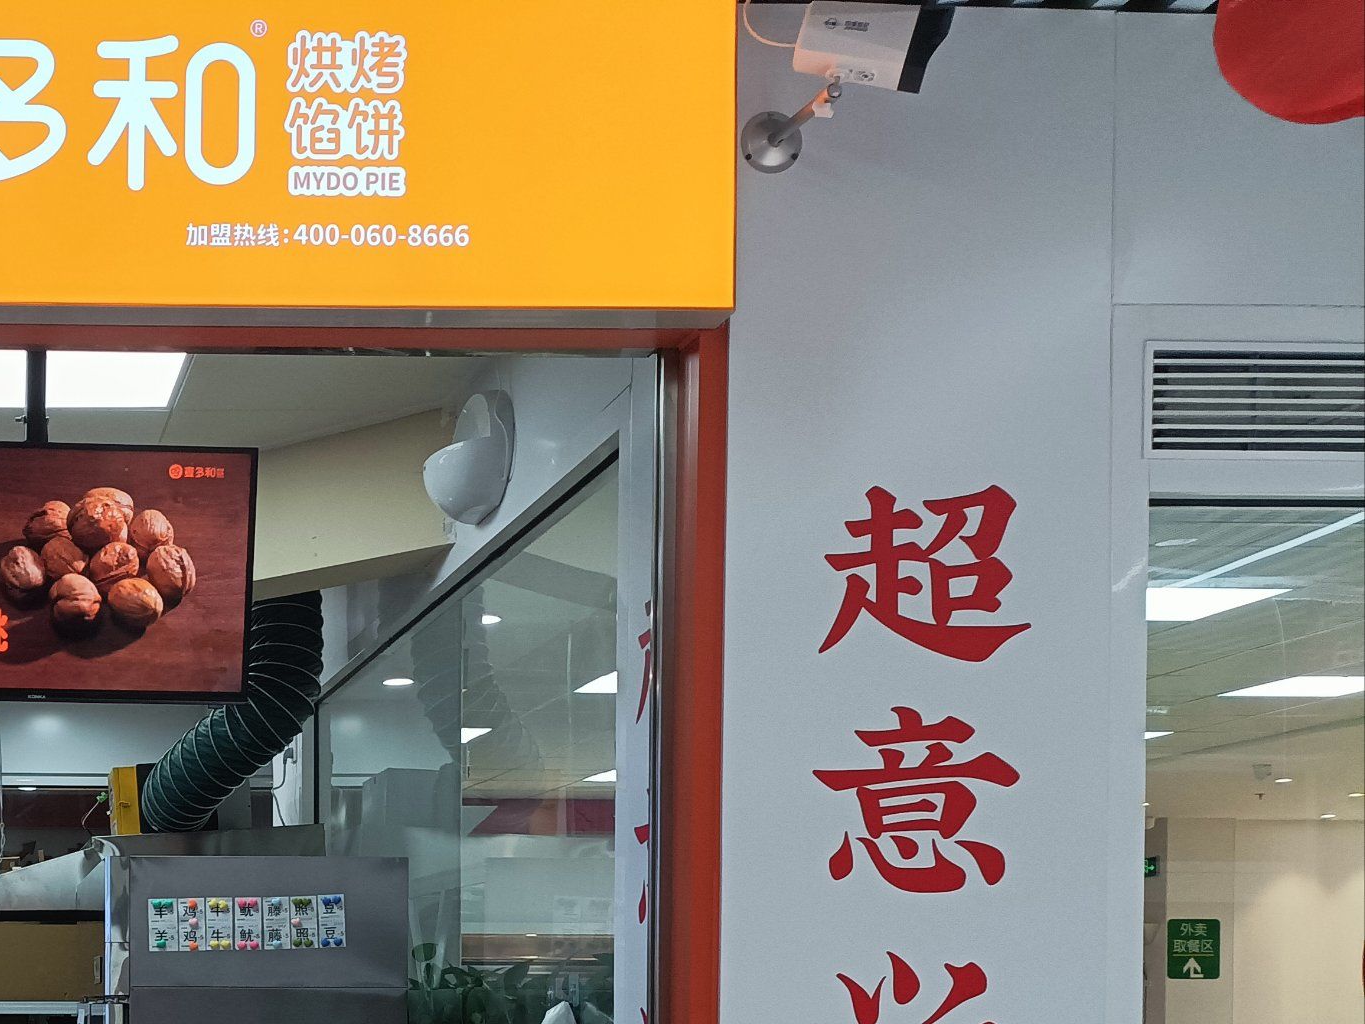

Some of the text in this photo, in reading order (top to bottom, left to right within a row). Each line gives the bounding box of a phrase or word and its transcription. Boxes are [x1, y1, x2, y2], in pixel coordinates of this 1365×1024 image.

[289, 31, 405, 93] 烘烤
[289, 100, 405, 159] 馅饼
[291, 170, 402, 193] MYDO PIE
[1180, 923, 1207, 936] 外卖
[1173, 939, 1214, 954] 取餐区
